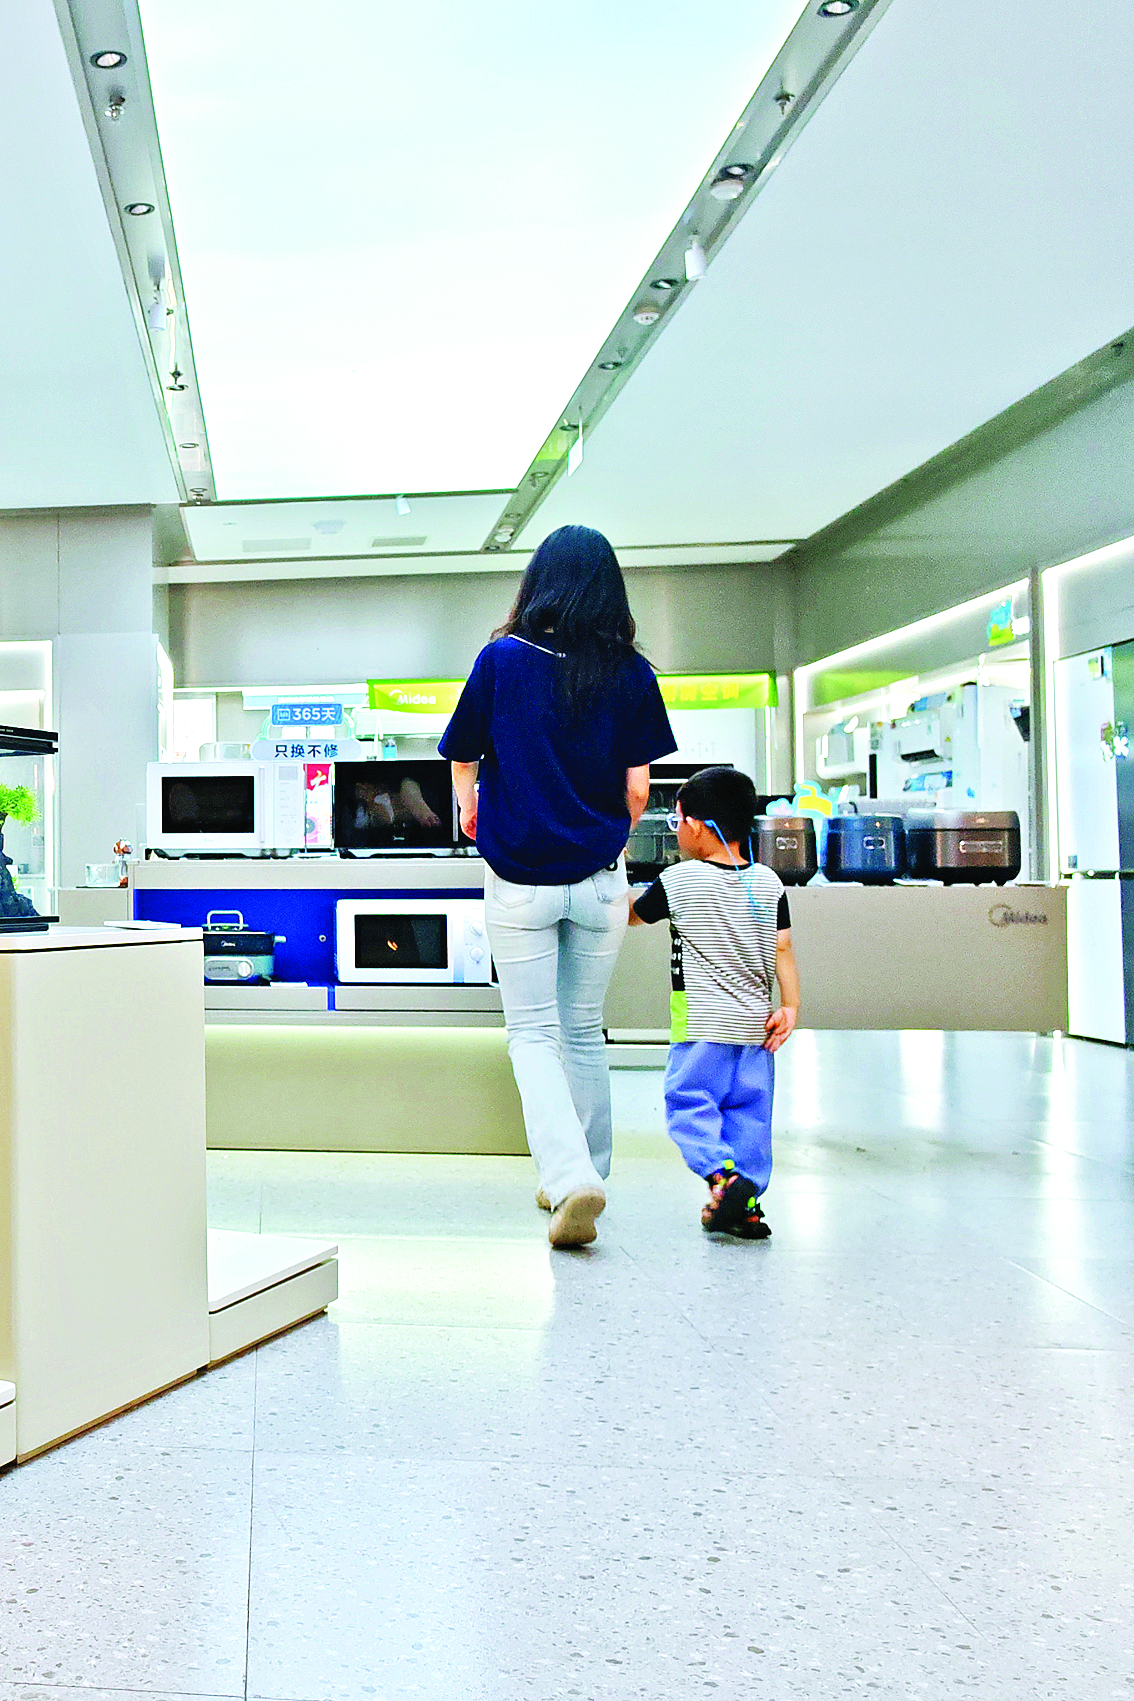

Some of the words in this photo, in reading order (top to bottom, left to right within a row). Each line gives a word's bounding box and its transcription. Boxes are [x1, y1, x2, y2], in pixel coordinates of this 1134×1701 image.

[389, 689, 436, 706] Midea
[292, 707, 336, 721] 365天
[274, 743, 339, 759] 只换不修
[988, 903, 1048, 928] Midea
